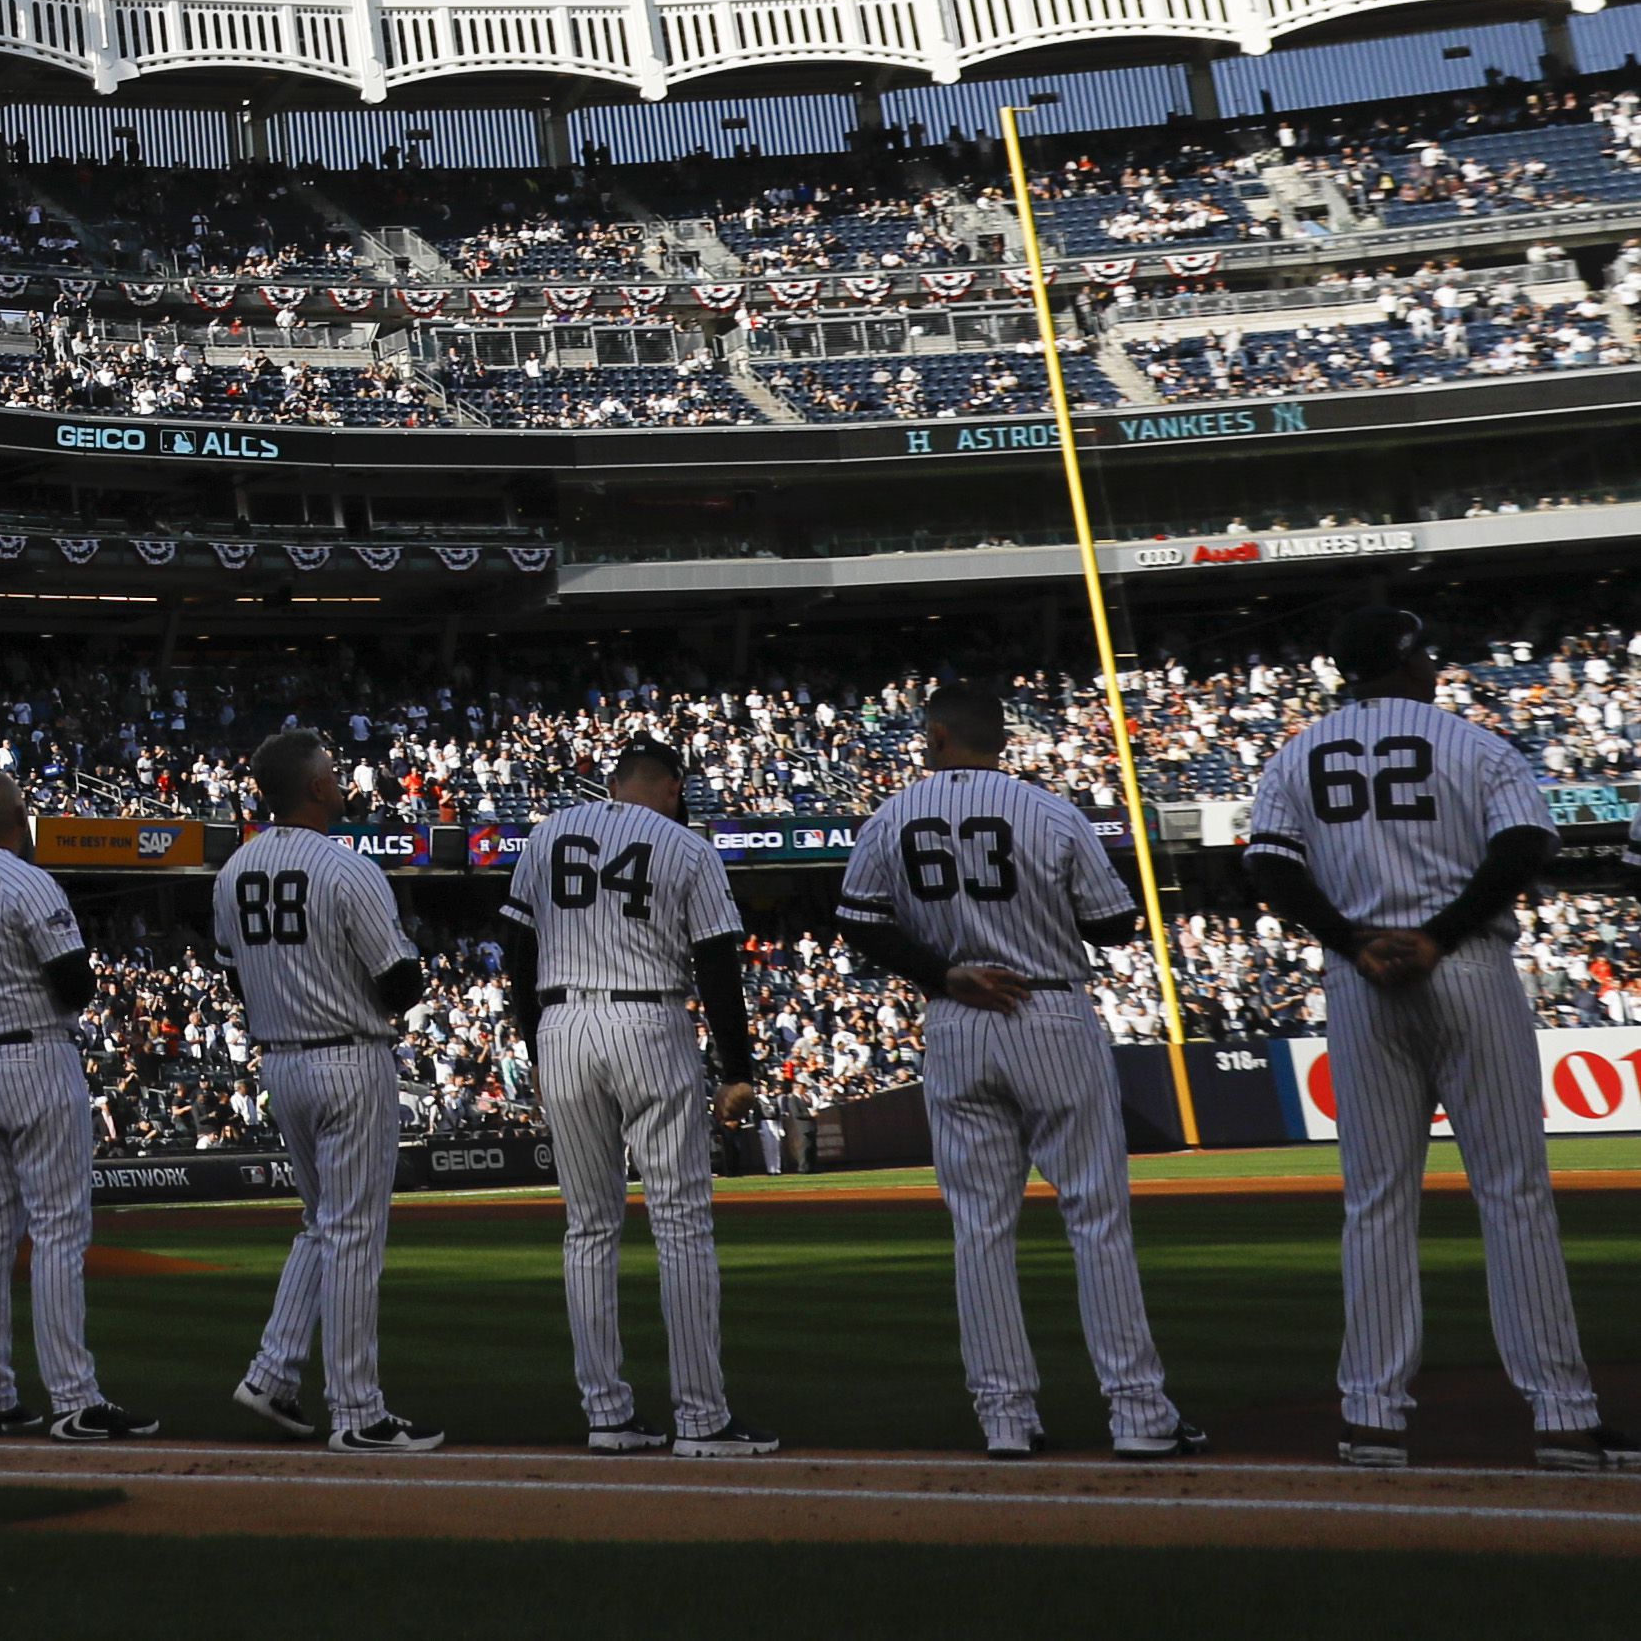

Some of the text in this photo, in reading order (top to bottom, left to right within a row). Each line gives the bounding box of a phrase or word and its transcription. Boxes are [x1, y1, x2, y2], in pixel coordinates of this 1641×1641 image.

[56, 424, 280, 458] GEICO ALCS
[956, 424, 1062, 451] ASTROS
[1118, 410, 1256, 442] YANKEES
[1192, 530, 1416, 564] Audi YANKEES CLUB
[1308, 735, 1437, 824] 62
[56, 831, 174, 854] THE BEST RUN SAP
[357, 834, 415, 855] ALCS
[712, 829, 858, 850] GEICO AL
[899, 815, 1018, 902] 63
[550, 833, 654, 921] 64
[235, 869, 309, 946] 88
[431, 1147, 504, 1172] GEICO
[108, 1167, 191, 1189] NETWORK
